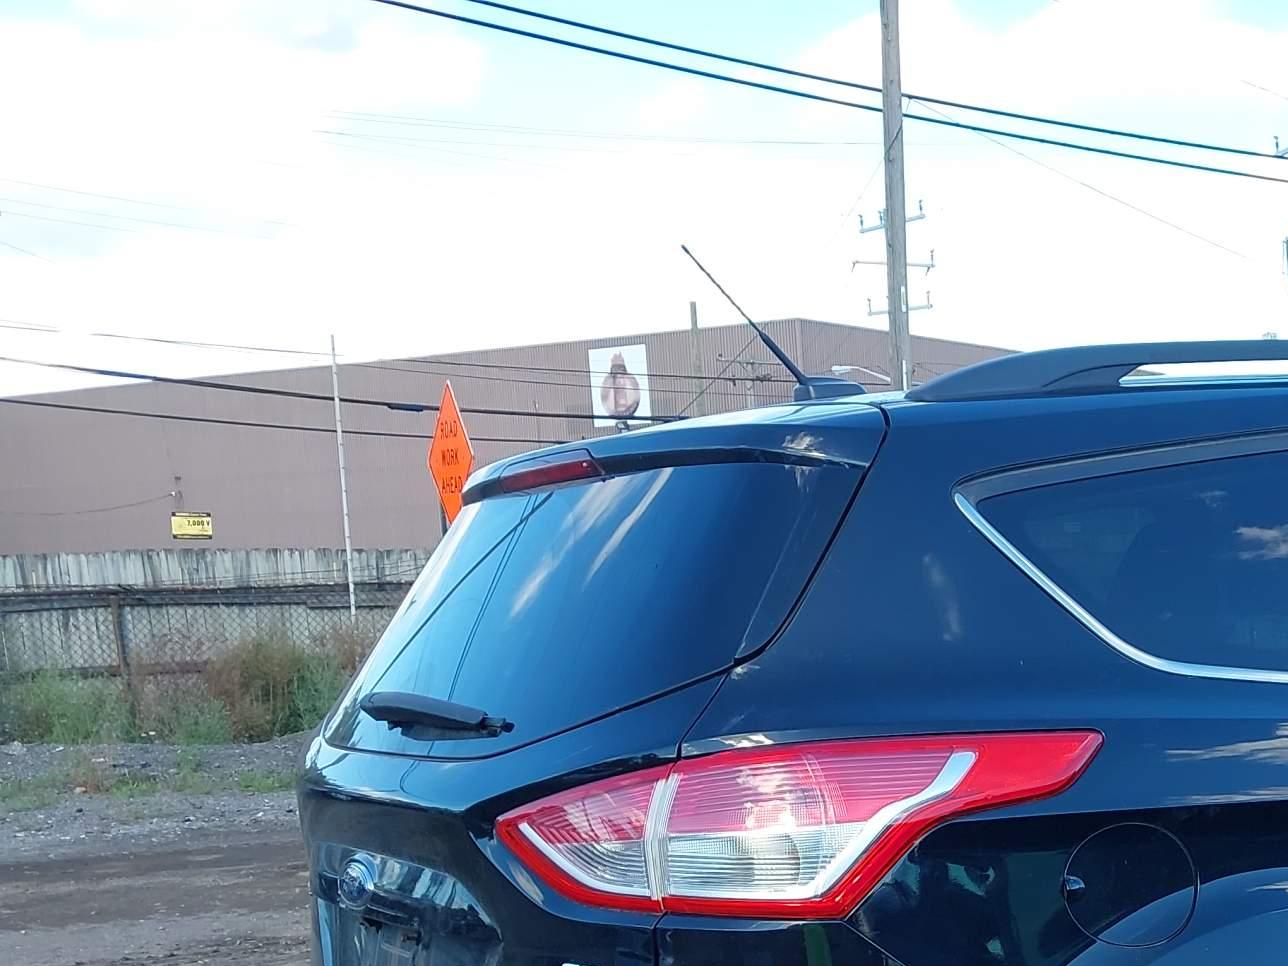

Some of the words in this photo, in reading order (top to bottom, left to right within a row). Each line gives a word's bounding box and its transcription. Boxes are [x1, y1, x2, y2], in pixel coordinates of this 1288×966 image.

[440, 420, 457, 440] ROAD
[441, 449, 459, 466] WORK
[441, 476, 462, 494] AHEAD
